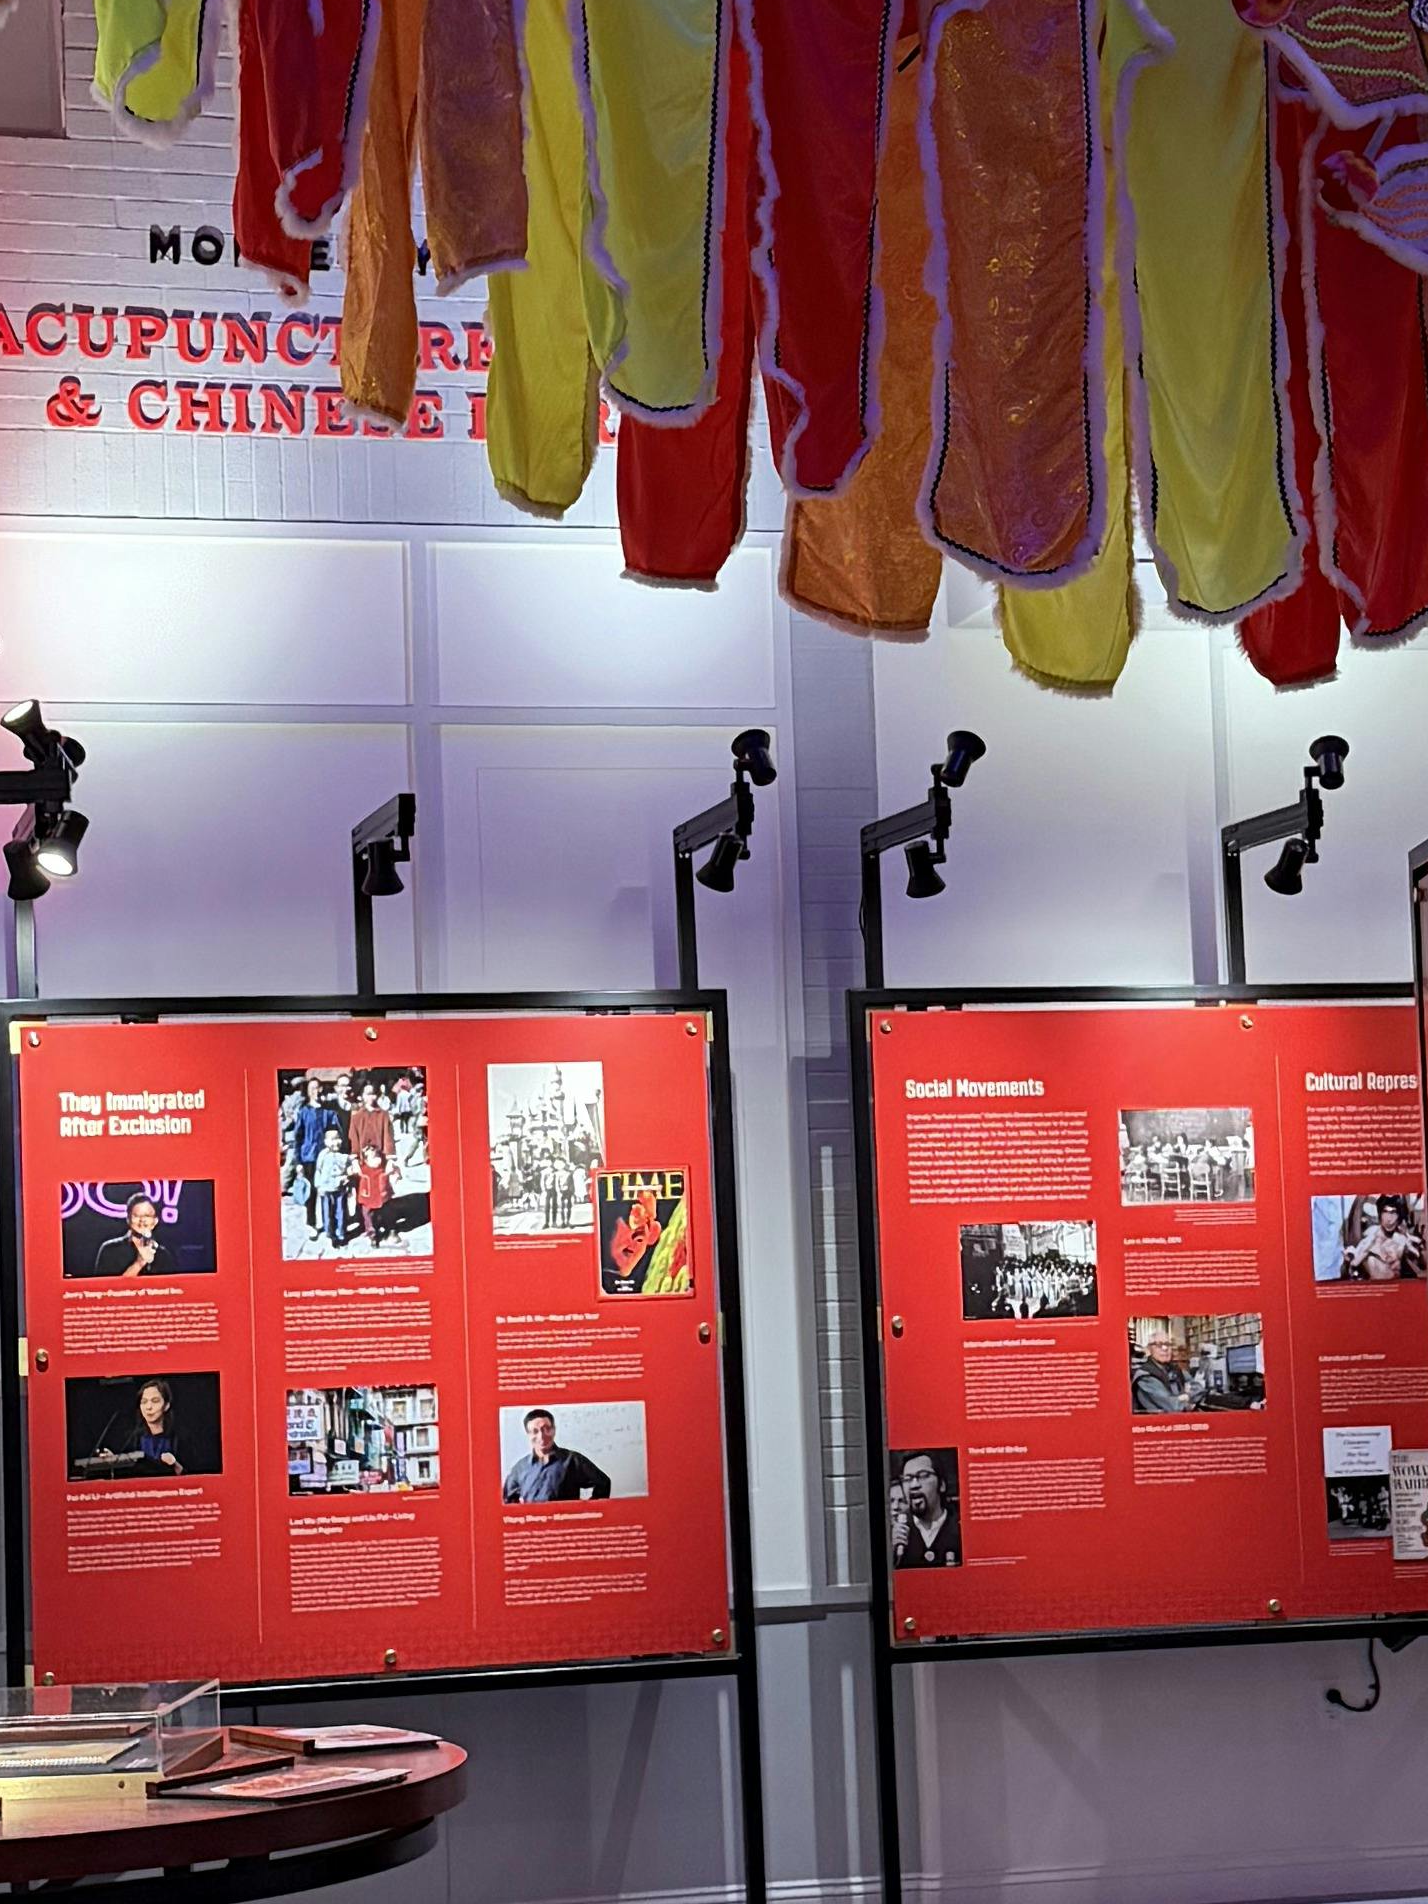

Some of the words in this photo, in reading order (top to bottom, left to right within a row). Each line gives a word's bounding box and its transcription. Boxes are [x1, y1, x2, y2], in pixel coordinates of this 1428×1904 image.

[45, 375, 102, 428] &
[127, 378, 445, 441] CHINEE
[905, 1078, 953, 1098] Social
[956, 1078, 1045, 1097] Movements
[1305, 1071, 1363, 1092] Cultural
[1367, 1071, 1418, 1093] Repres
[59, 1091, 102, 1115] They
[106, 1089, 205, 1114] Immigrated
[59, 1115, 105, 1137] After
[108, 1114, 192, 1136] Exclusion
[598, 1172, 683, 1202] TIME
